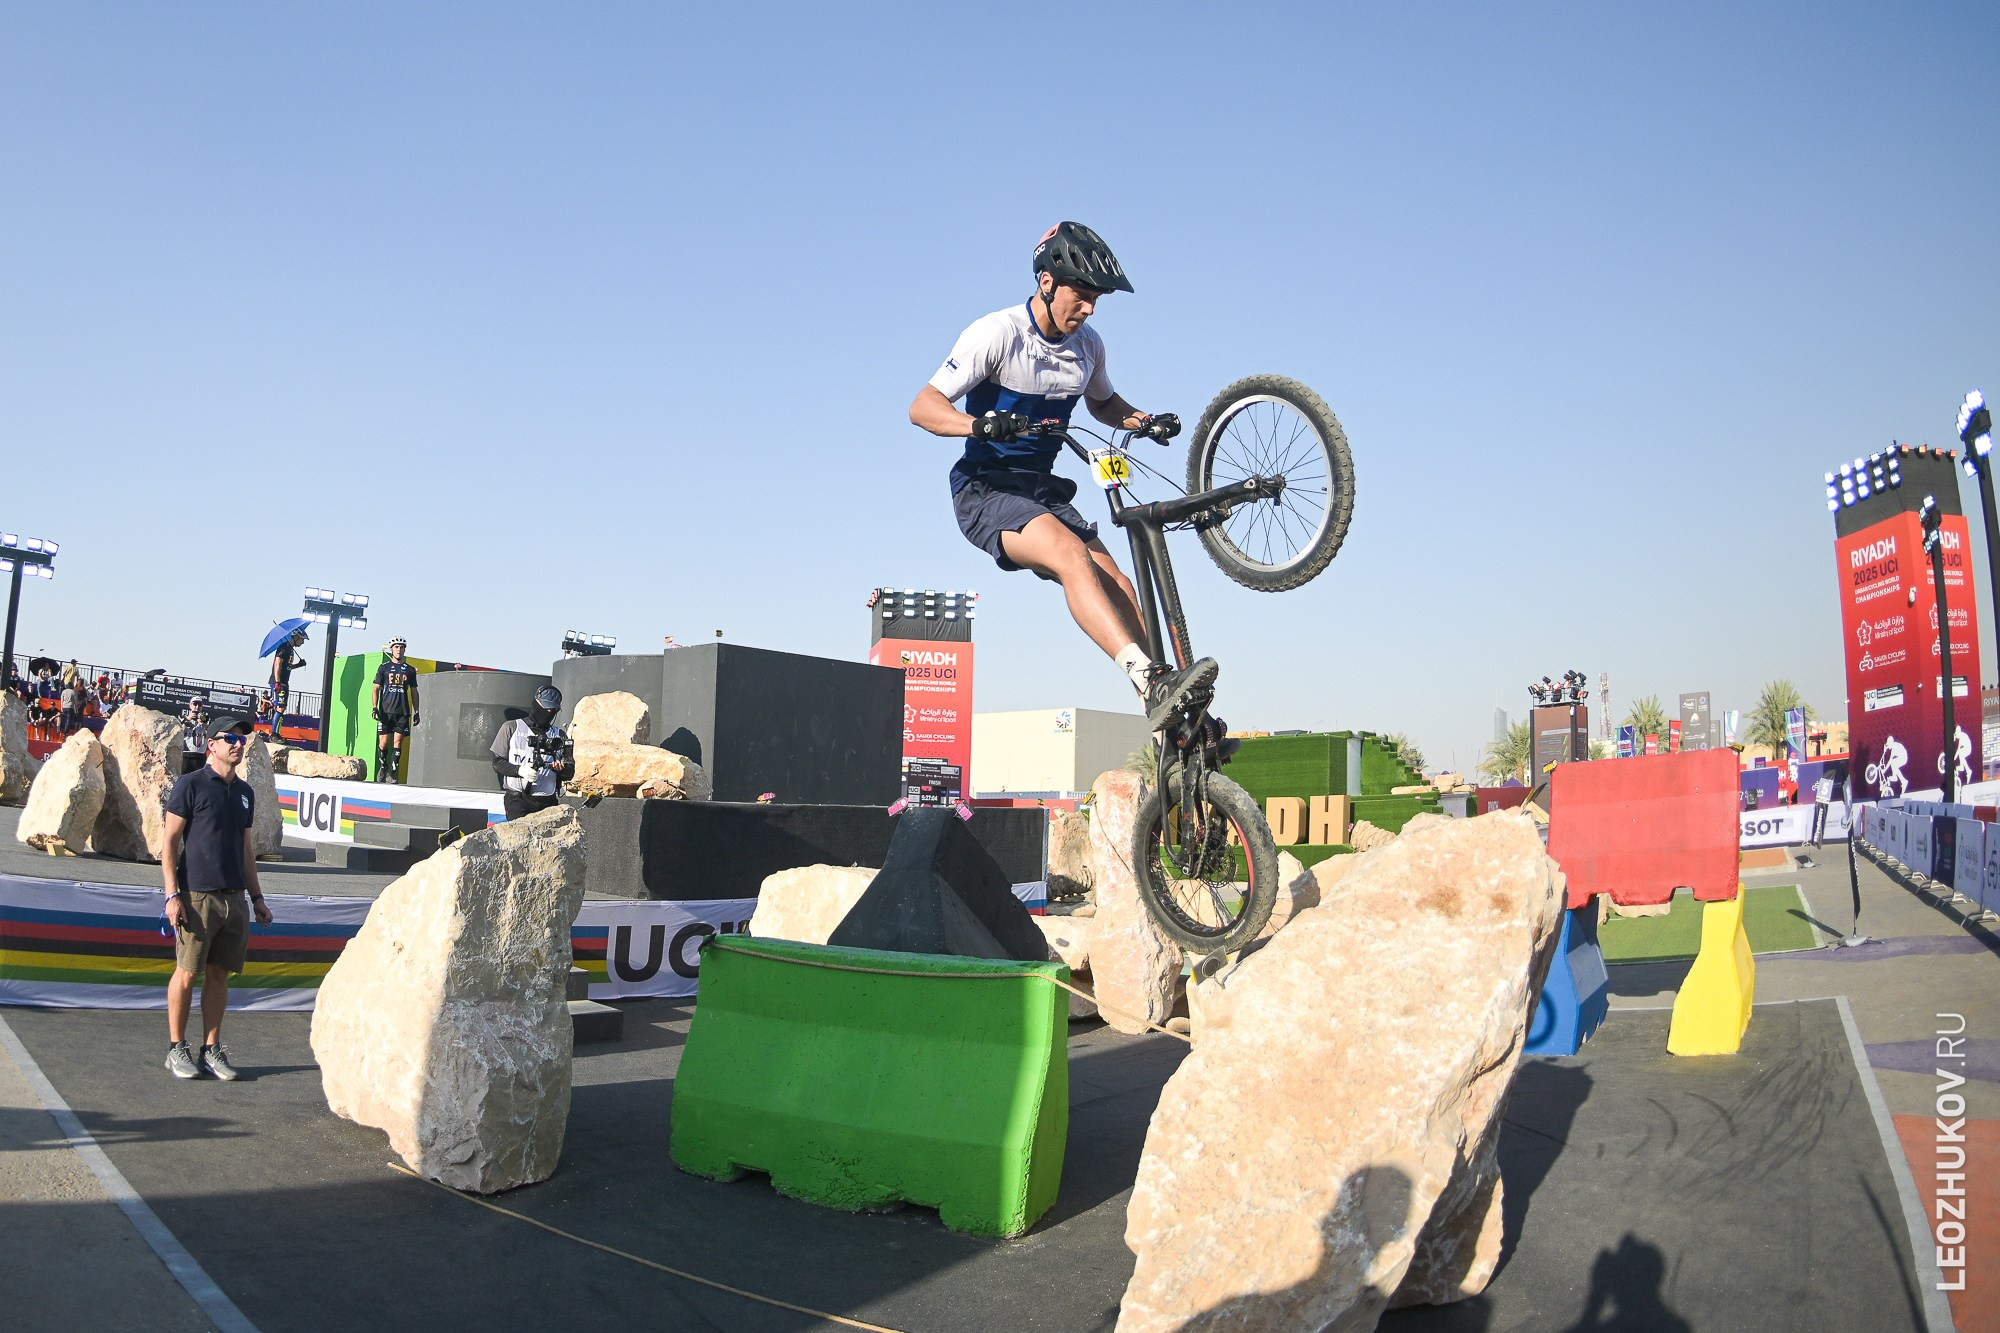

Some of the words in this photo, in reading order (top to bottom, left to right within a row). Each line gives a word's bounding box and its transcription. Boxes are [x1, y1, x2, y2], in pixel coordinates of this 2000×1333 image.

[1108, 460, 1123, 475] 12
[1850, 535, 1896, 569] RIYADH
[1947, 553, 1963, 567] UCI
[1853, 566, 1878, 585] 2025
[1879, 558, 1899, 577] UCI
[1855, 584, 1900, 604] CHAMPIONSHIPS
[901, 650, 957, 666] RIYADH
[388, 672, 408, 685] ESP
[934, 668, 957, 679] UCI
[147, 684, 163, 694] UCI
[1821, 781, 1831, 795] 5
[299, 791, 337, 833] UCI
[615, 922, 733, 982] UC
